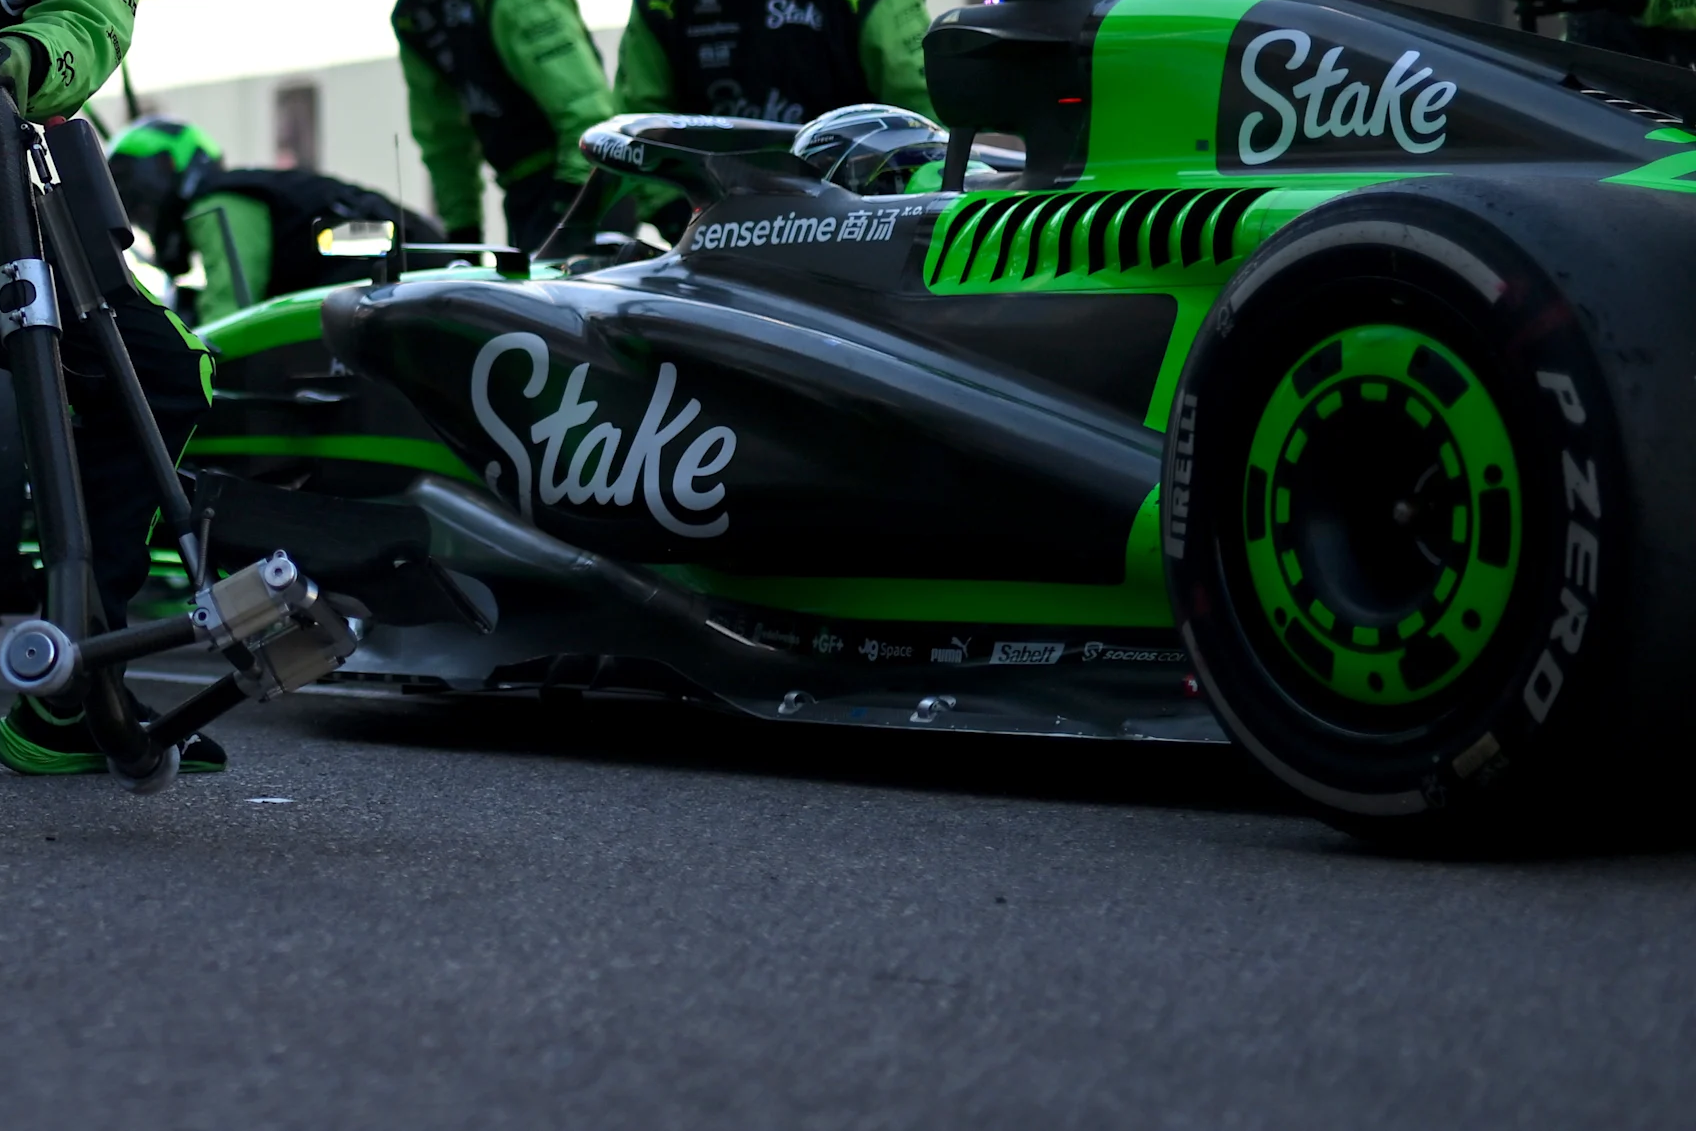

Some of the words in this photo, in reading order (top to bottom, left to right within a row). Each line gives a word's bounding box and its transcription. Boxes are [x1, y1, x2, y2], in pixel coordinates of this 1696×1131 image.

[1238, 28, 1458, 166] Stake
[592, 136, 645, 167] Hyland
[690, 211, 836, 252] sensetime
[836, 209, 901, 242] 商汤
[470, 331, 738, 539] Stake
[1163, 386, 1200, 561] PIRELLI
[929, 647, 963, 664] PUMA
[998, 644, 1057, 663] Sabelt
